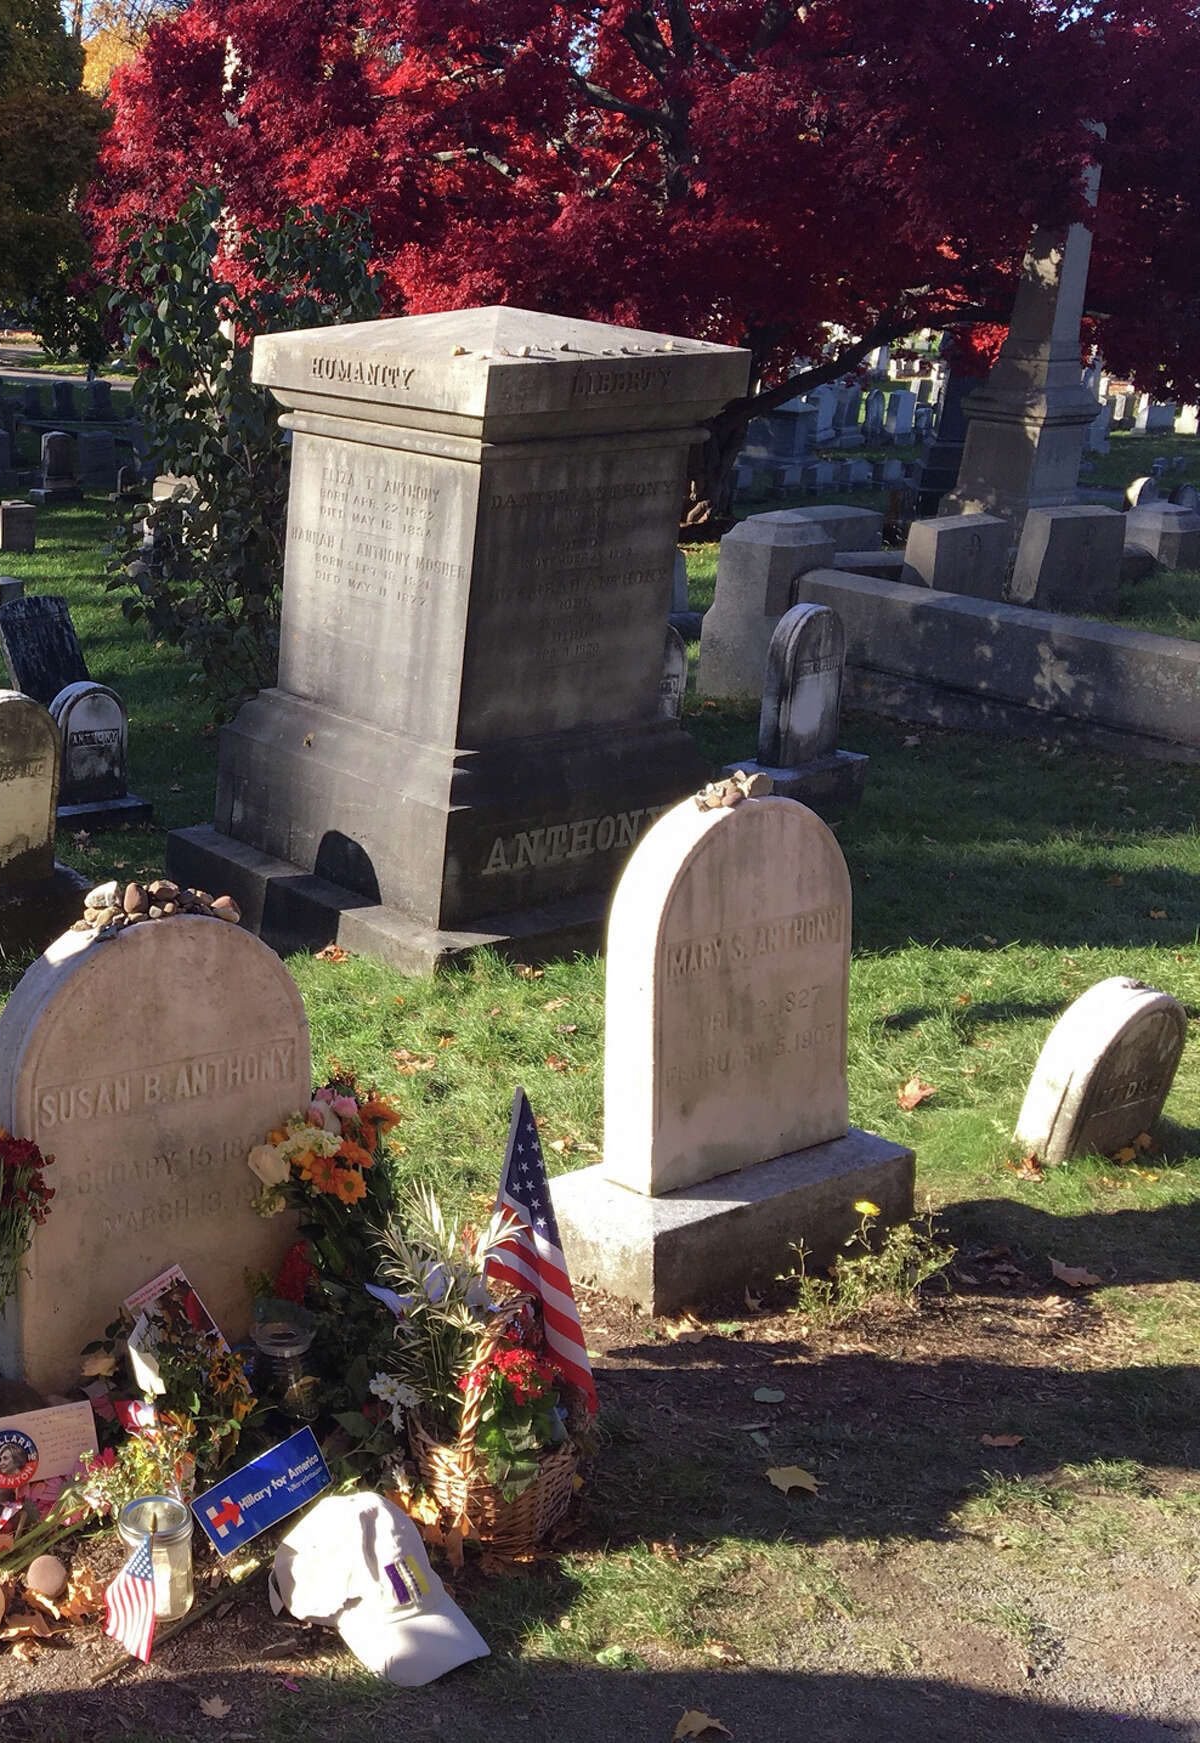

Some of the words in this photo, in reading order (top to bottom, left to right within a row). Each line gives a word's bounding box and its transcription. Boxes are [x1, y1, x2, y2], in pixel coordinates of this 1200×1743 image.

[311, 357, 415, 390] HUMANITY
[572, 367, 672, 396] LIBERTY
[320, 488, 348, 503] BORN
[321, 467, 353, 488] ELIZA
[384, 480, 440, 502] ANTHONY
[320, 506, 345, 519] DIED
[352, 513, 375, 525] MAY
[290, 527, 335, 548] HANNAH
[356, 543, 410, 567] ANTHONY
[416, 556, 467, 580] MOSHER
[315, 552, 343, 568] BORN
[315, 570, 341, 585] DIED
[348, 578, 371, 593] MAY
[667, 938, 721, 979] MARY
[731, 931, 748, 960] S.
[753, 908, 841, 955] ANTHONY
[38, 1079, 131, 1129] SUSAN
[145, 1073, 167, 1106] B.
[175, 1048, 295, 1098] ANTHONY
[104, 1199, 189, 1234] MARCH
[238, 1486, 273, 1511] Hillary
[270, 1475, 288, 1490] for
[287, 1454, 319, 1480] America
